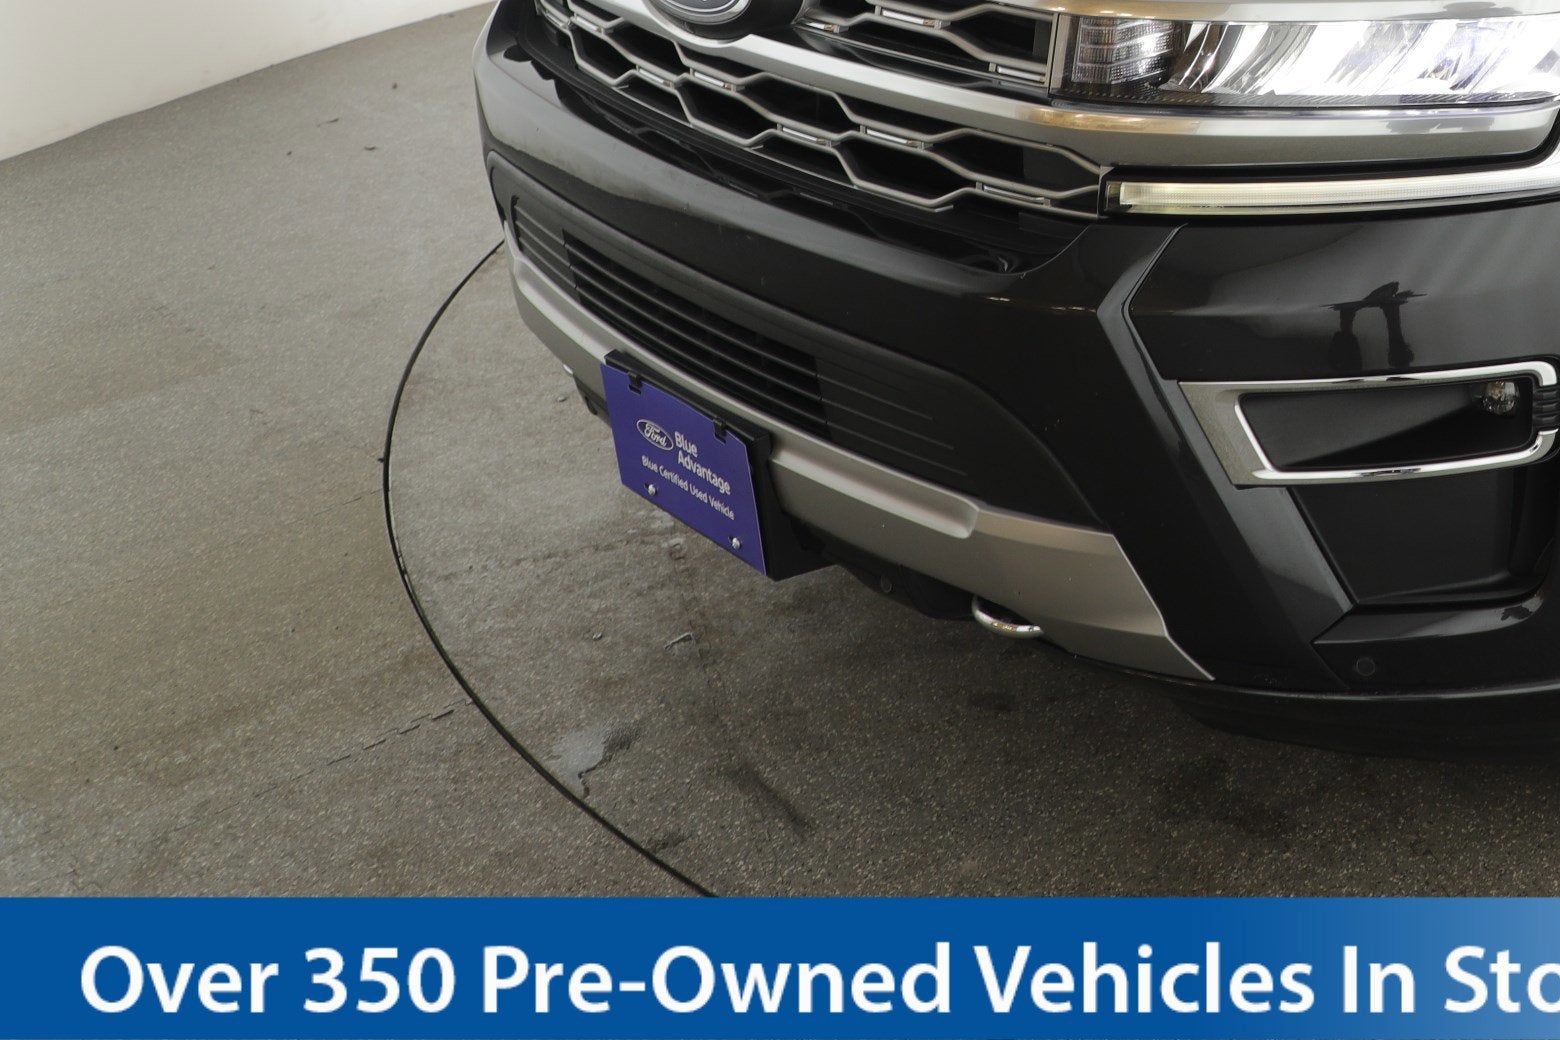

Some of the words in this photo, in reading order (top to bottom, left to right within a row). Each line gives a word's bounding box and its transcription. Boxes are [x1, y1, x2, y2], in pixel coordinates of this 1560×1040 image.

[643, 423, 667, 448] Ford
[675, 431, 698, 458] Blue
[641, 455, 658, 473] Blue
[659, 464, 689, 492] Certified
[690, 483, 708, 504] Used
[709, 492, 735, 521] Vehicle
[678, 451, 731, 495] Advantage
